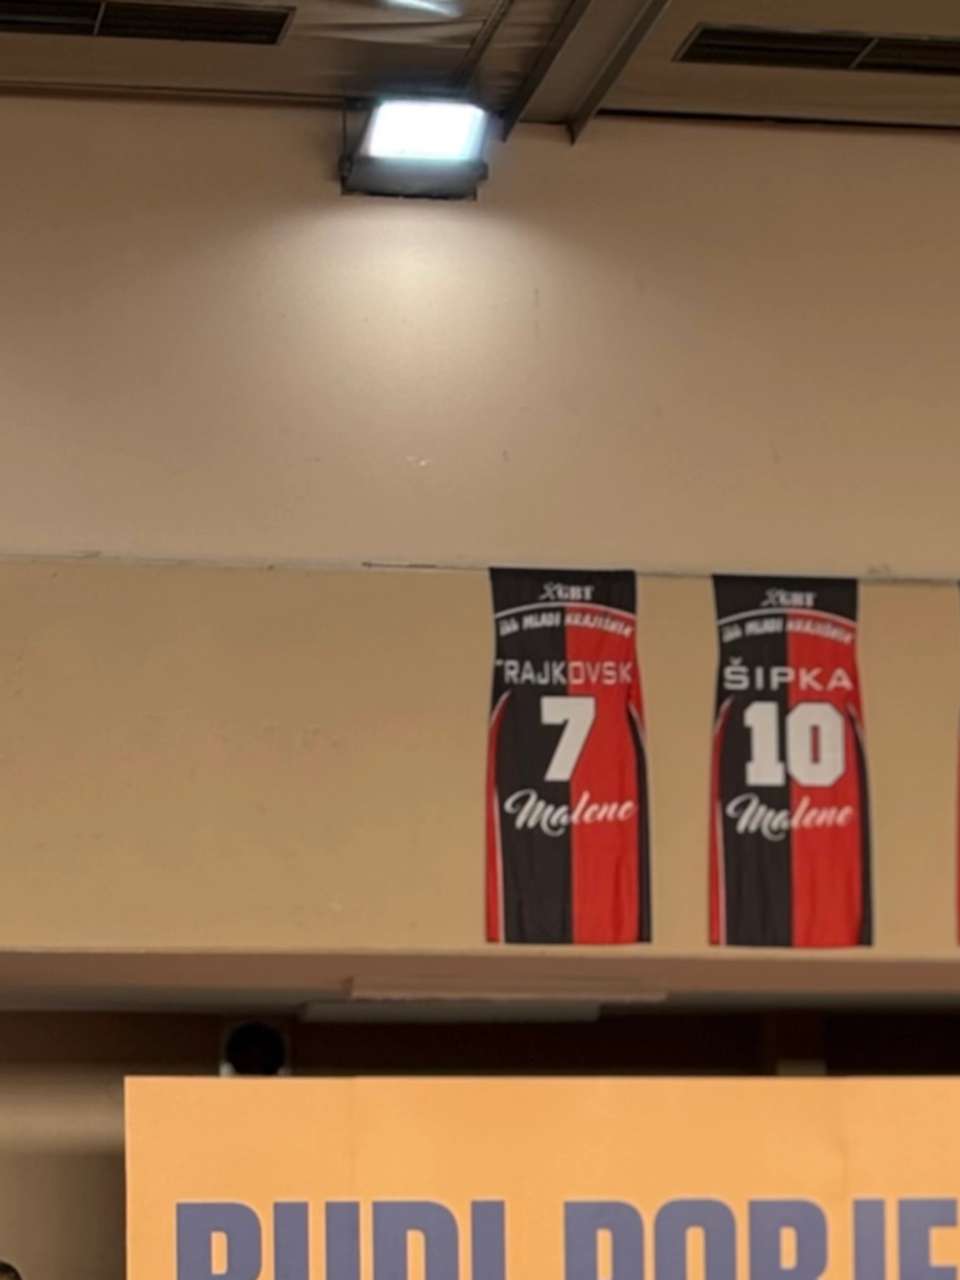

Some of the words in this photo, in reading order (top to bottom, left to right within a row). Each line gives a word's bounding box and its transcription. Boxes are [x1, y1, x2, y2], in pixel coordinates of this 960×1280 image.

[723, 656, 853, 691] ŠIPKA
[540, 696, 597, 782] 7
[743, 701, 845, 787] 10
